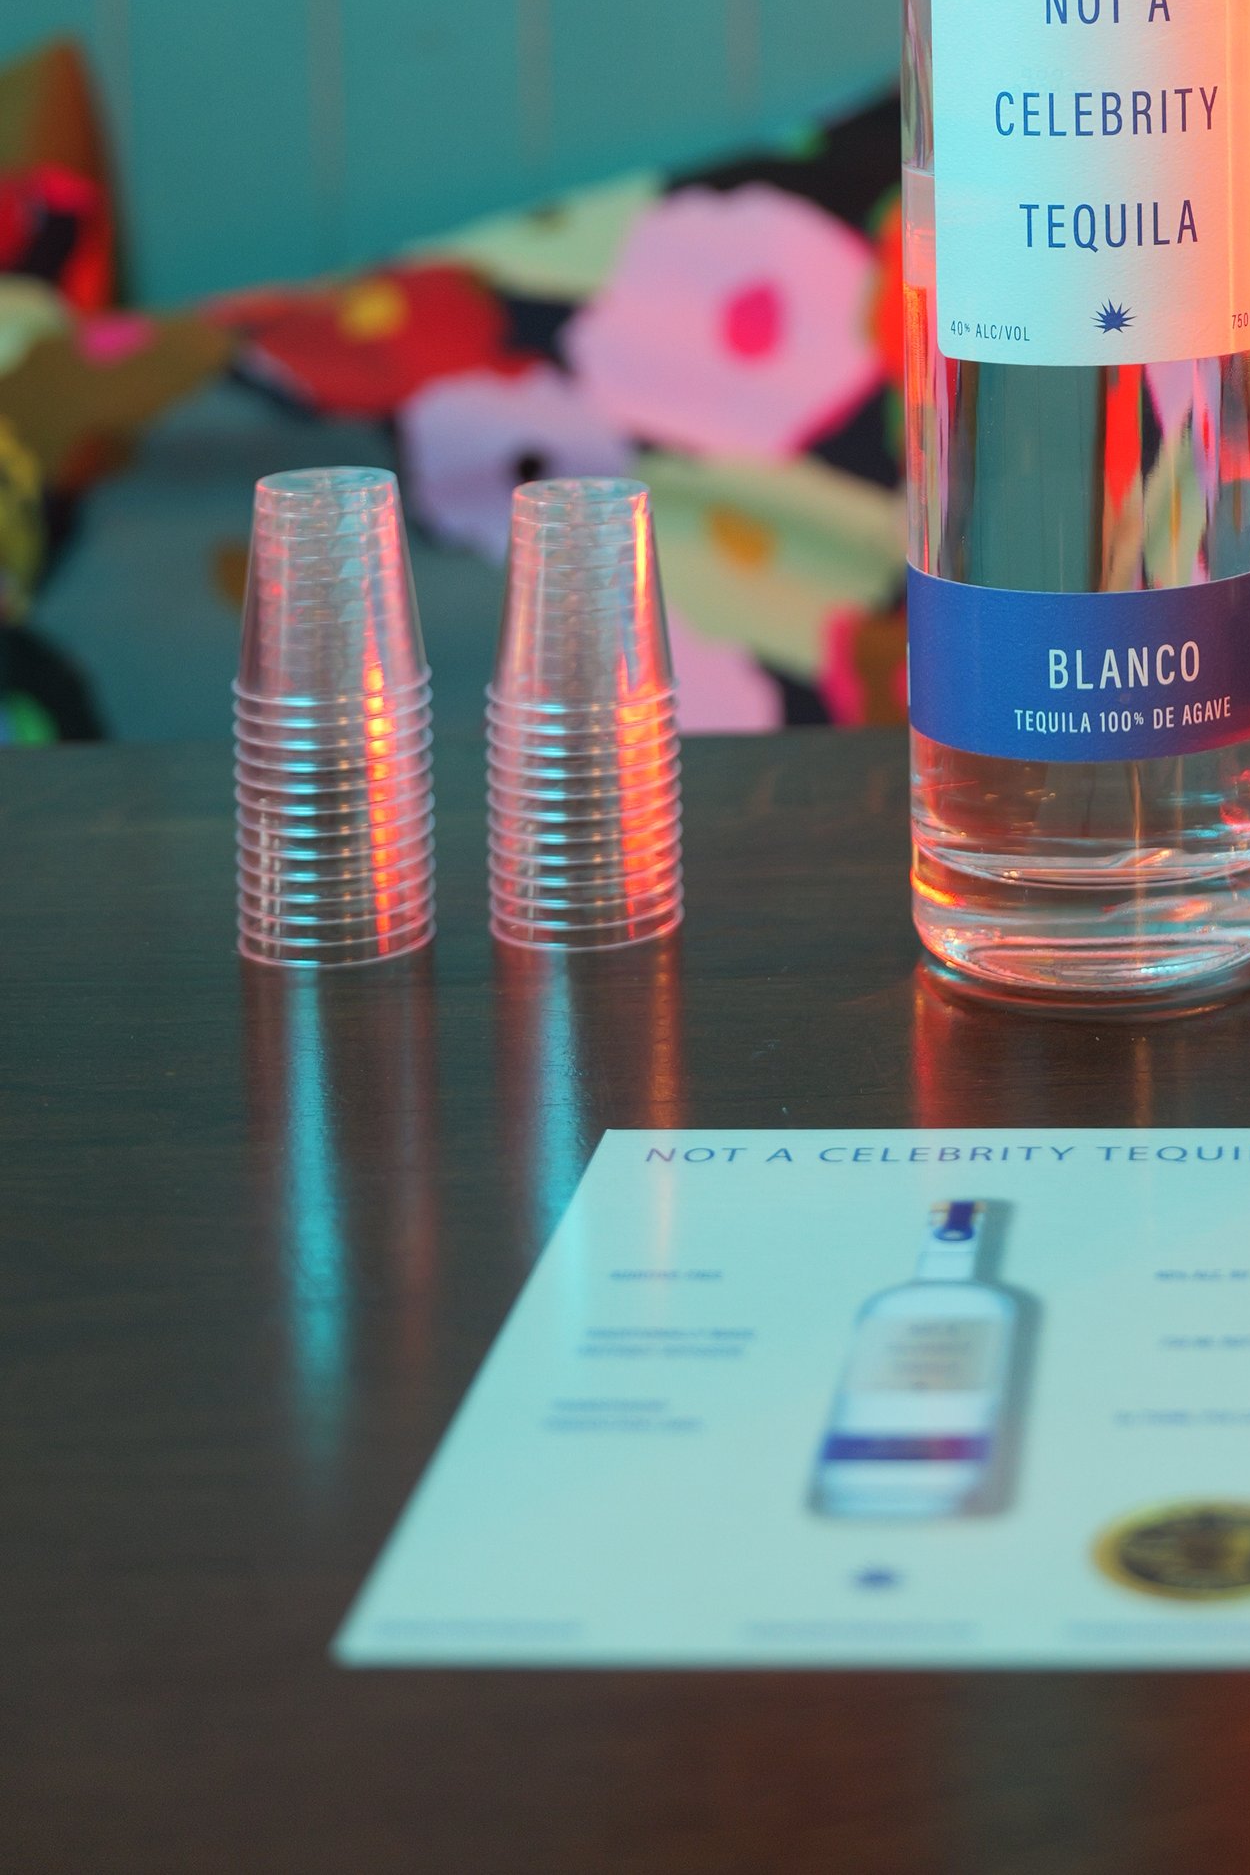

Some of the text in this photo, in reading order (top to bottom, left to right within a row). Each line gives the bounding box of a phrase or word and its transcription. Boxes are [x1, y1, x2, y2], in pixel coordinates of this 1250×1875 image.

[995, 86, 1219, 137] CELEBRITY
[1019, 199, 1198, 253] TEQUILA
[950, 320, 1031, 342] 40% ALC/VOL
[1048, 640, 1201, 690] BLANCO
[1014, 696, 1231, 734] TEQUILA 100% DE AGAVE
[645, 1147, 748, 1163] NOT
[766, 1147, 793, 1163] A
[819, 1145, 1077, 1163] CELEBRITY
